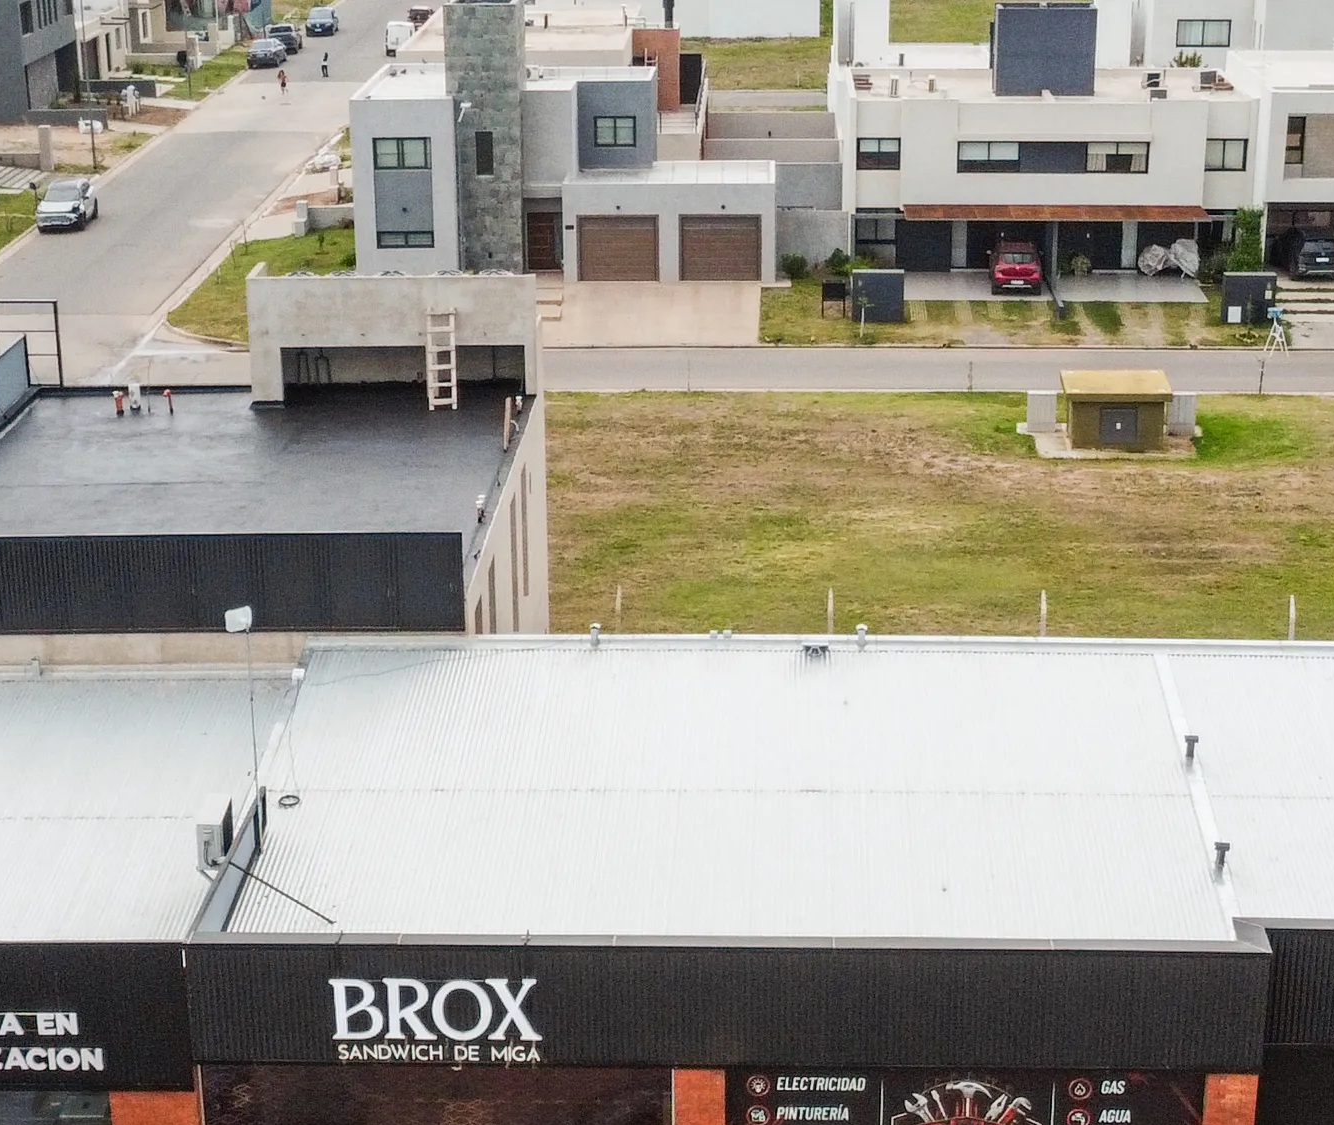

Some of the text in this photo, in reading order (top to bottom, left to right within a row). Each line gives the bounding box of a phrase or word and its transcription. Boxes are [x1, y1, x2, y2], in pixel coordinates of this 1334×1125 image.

[327, 977, 543, 1042] BROX
[36, 1011, 79, 1036] EN
[338, 1043, 541, 1063] SANDWICH DE MIGA
[776, 1076, 867, 1092] ELECTRICIDAD
[1100, 1080, 1127, 1095] GAS
[776, 1103, 850, 1121] PINTURERÍA
[1098, 1110, 1132, 1124] AGUA
